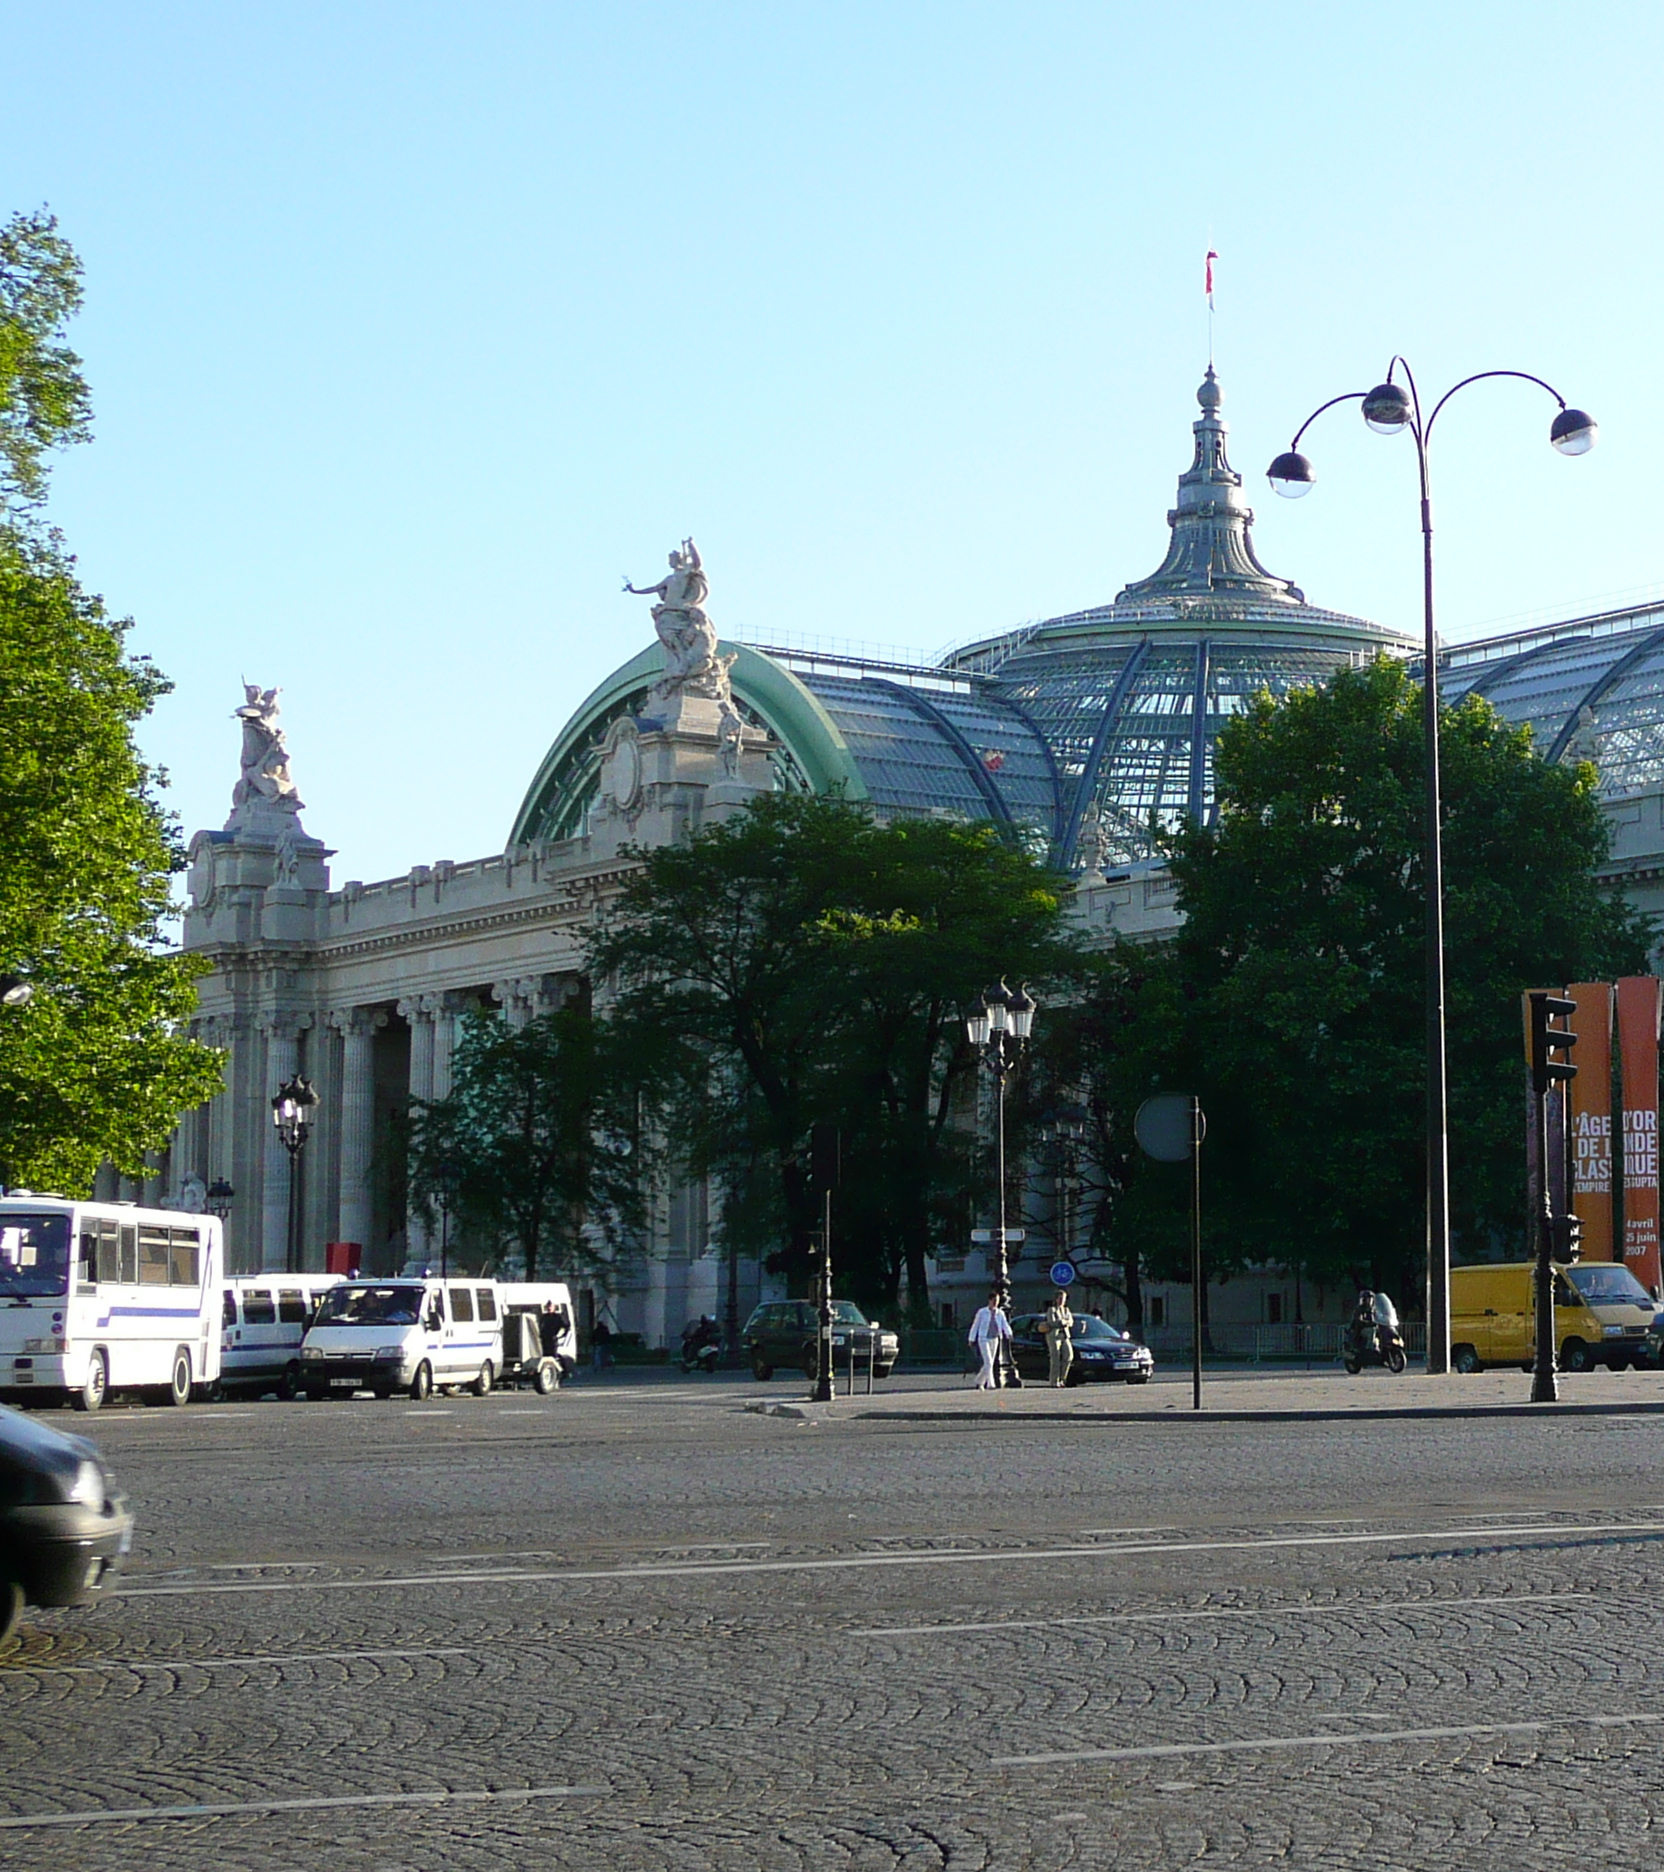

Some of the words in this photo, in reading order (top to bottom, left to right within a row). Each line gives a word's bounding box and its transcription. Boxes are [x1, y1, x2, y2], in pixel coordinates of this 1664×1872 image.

[1622, 1110, 1656, 1131] D'OR
[1577, 1138, 1599, 1158] DE
[1631, 1218, 1654, 1228] avril
[1636, 1232, 1657, 1244] juin
[1625, 1246, 1647, 1256] 2007
